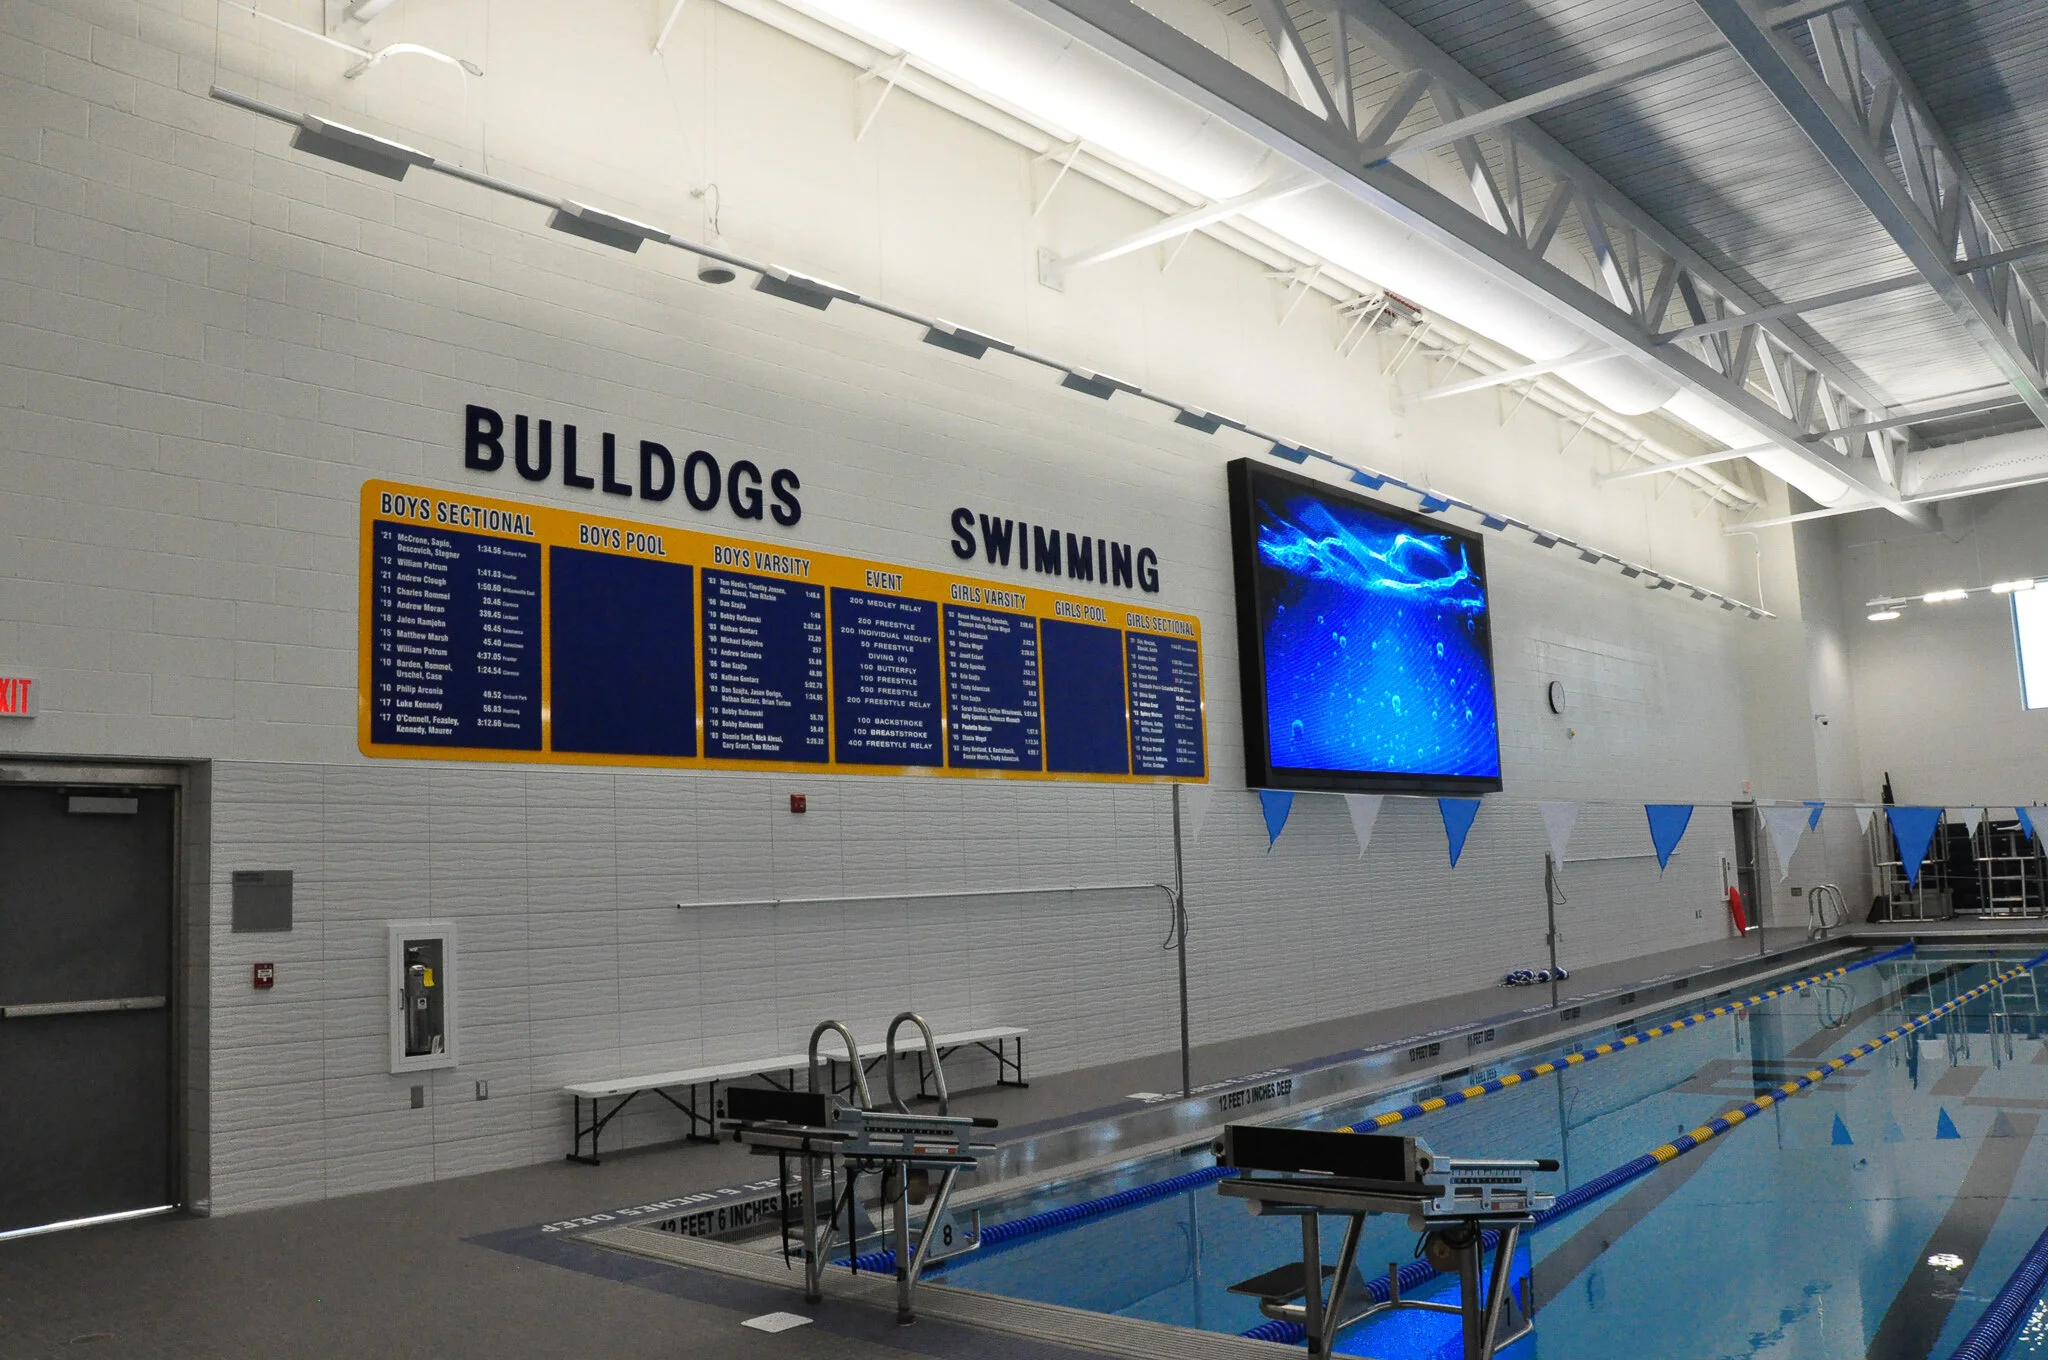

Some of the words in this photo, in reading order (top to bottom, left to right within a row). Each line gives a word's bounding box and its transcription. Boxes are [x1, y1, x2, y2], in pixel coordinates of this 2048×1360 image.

[465, 404, 802, 527] BULLDOGS
[380, 492, 431, 521] BOYS
[437, 501, 534, 537] SECTIONAL
[397, 533, 429, 545] McCrone,
[431, 537, 452, 548] Sapio,
[579, 523, 621, 548] BOYS
[626, 531, 666, 556] POOL
[397, 543, 433, 557] Descovich,
[434, 548, 460, 559] Stegner
[951, 507, 1160, 593] SWIMMING
[397, 558, 422, 568] William
[423, 561, 448, 571] Patrum
[714, 546, 750, 568] BOYS
[754, 551, 811, 577] VARSITY
[396, 572, 422, 582] Andrew
[423, 575, 446, 587] Clough
[865, 570, 902, 591] EVENT
[396, 587, 422, 597] Charles
[424, 590, 450, 600] Rommel
[951, 584, 981, 603] GIRLS
[984, 591, 1027, 610] VARSITY
[396, 600, 422, 610] Andrew
[423, 603, 445, 613] Moran
[849, 597, 864, 605] 200
[867, 599, 896, 609] MEDLEY
[899, 604, 921, 612] RELAY
[1055, 600, 1081, 618] GIRLS
[1083, 605, 1107, 622] POOL
[396, 615, 416, 624] Jalen
[417, 617, 446, 628] Ramjohn
[858, 617, 872, 625] 200
[875, 619, 915, 630] FREESTYLE
[1126, 612, 1151, 630] GIRLS
[1152, 616, 1195, 637] SECTIONAL
[396, 629, 426, 640] Matthew
[427, 632, 448, 642] Marsh
[840, 626, 855, 634] 200
[858, 628, 900, 640] INDIVIDUAL
[903, 634, 931, 643] MEDLEY
[396, 644, 422, 654] William
[423, 646, 448, 656] Patrum
[861, 640, 870, 648] 50
[873, 642, 914, 652] FREESTYLE
[868, 652, 894, 661] DIVING
[396, 659, 423, 669] Barden,
[424, 661, 453, 672] Rommel,
[877, 664, 916, 674] BUTTERFLY
[396, 669, 424, 680] Urschel,
[425, 671, 442, 681] Case
[877, 676, 917, 686] FREESTYLE
[396, 684, 416, 694] Philip
[877, 687, 918, 697] FREESTYLE
[0, 678, 32, 714] XIT
[864, 697, 905, 707] FREESTYLE
[396, 699, 413, 708] Luke
[414, 700, 443, 711] Kennedy
[396, 713, 431, 724] O'Connell,
[432, 715, 459, 726] Feasley,
[874, 718, 923, 727] BACKSTROKE
[396, 724, 426, 735] Kennedy,
[428, 726, 452, 735] Maurer
[870, 729, 927, 738] BREASTSTROKE
[866, 740, 907, 748] FREESTYLE
[1416, 1045, 1428, 1060] FEET
[1429, 1042, 1441, 1057] DEEP
[1219, 1095, 1227, 1112] 12
[1228, 1091, 1245, 1109] FEET
[1246, 1090, 1250, 1103] 3
[1252, 1083, 1275, 1101] INCHES
[1276, 1079, 1293, 1097] DEEP
[617, 1194, 718, 1217] INCHES
[541, 1213, 616, 1233] DEEP
[681, 1211, 714, 1237] FEET
[718, 1208, 726, 1230] 6
[730, 1197, 778, 1228] INCHES
[943, 1224, 953, 1246] 8
